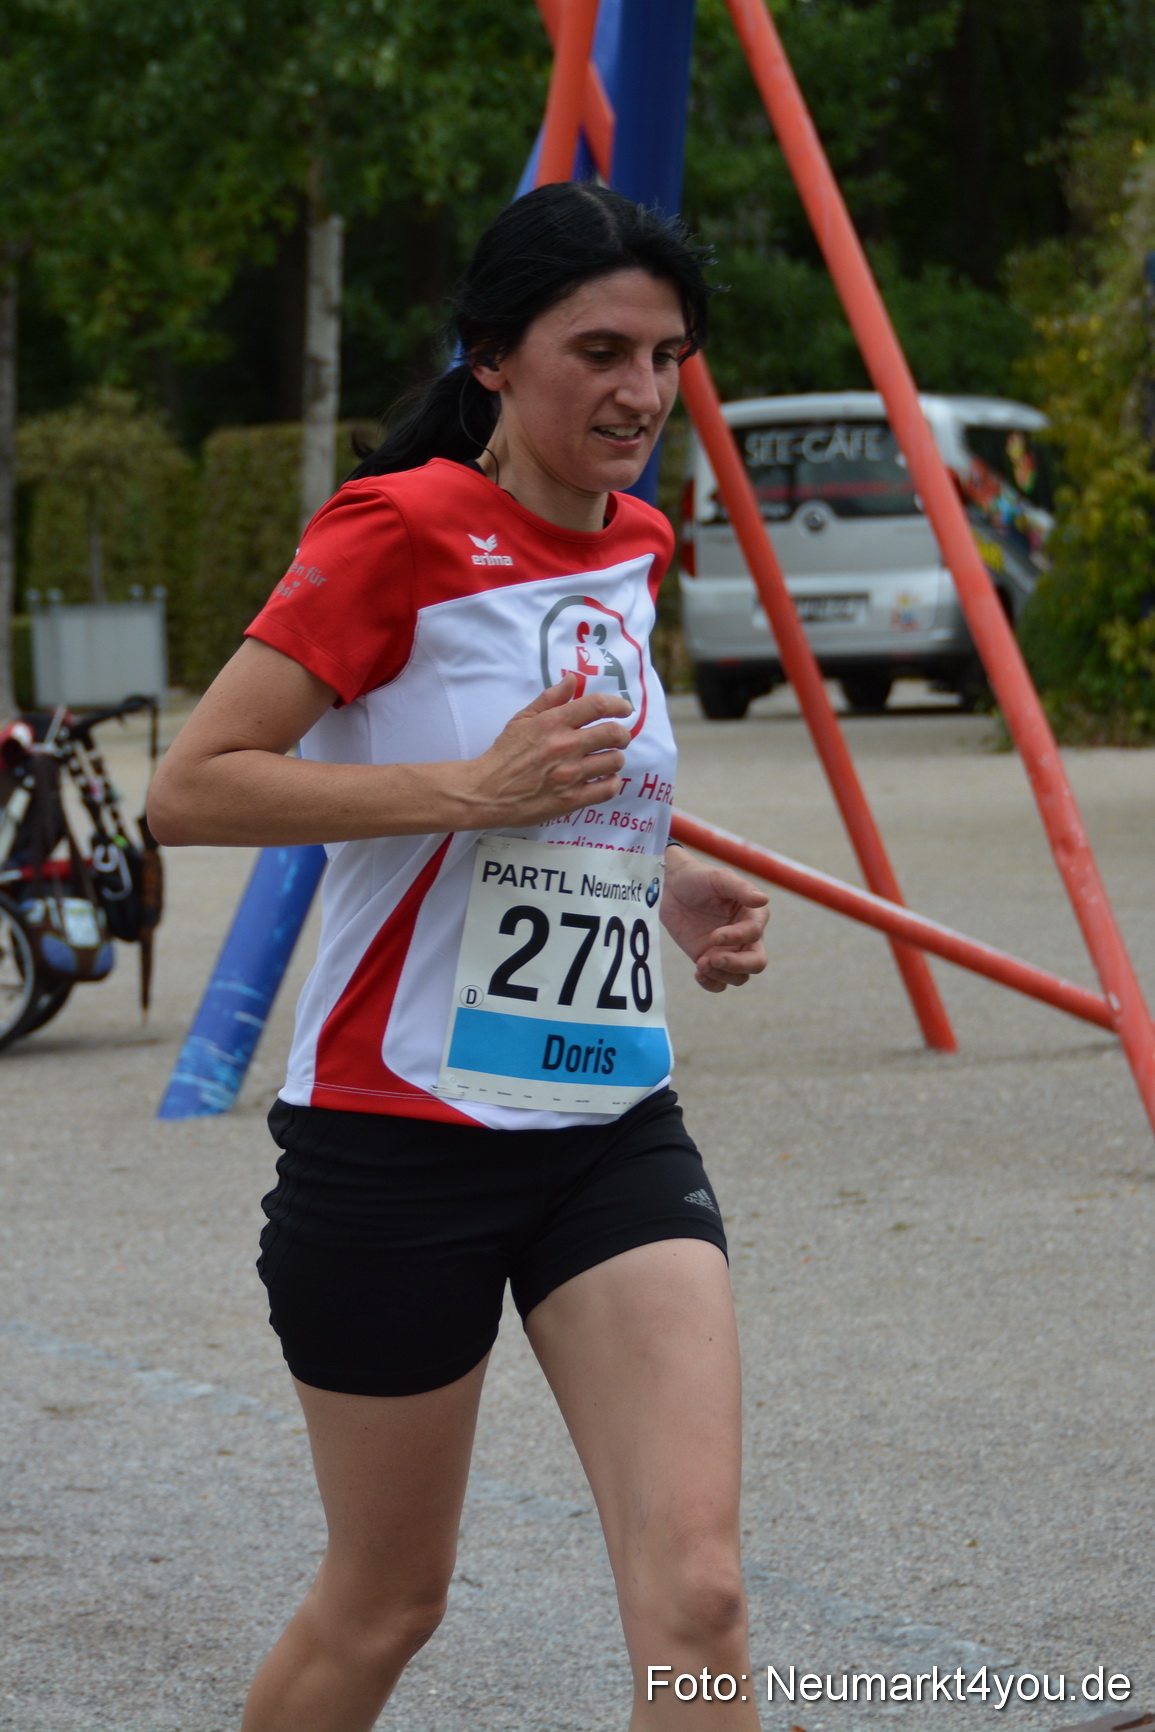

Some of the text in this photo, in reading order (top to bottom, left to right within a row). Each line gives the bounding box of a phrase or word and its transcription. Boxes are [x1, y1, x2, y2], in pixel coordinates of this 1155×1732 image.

[472, 552, 513, 566] erima
[482, 860, 643, 903] PARTL Neumarkt
[487, 904, 653, 1013] 2728
[466, 988, 477, 1005] D
[541, 1033, 617, 1075] Doris
